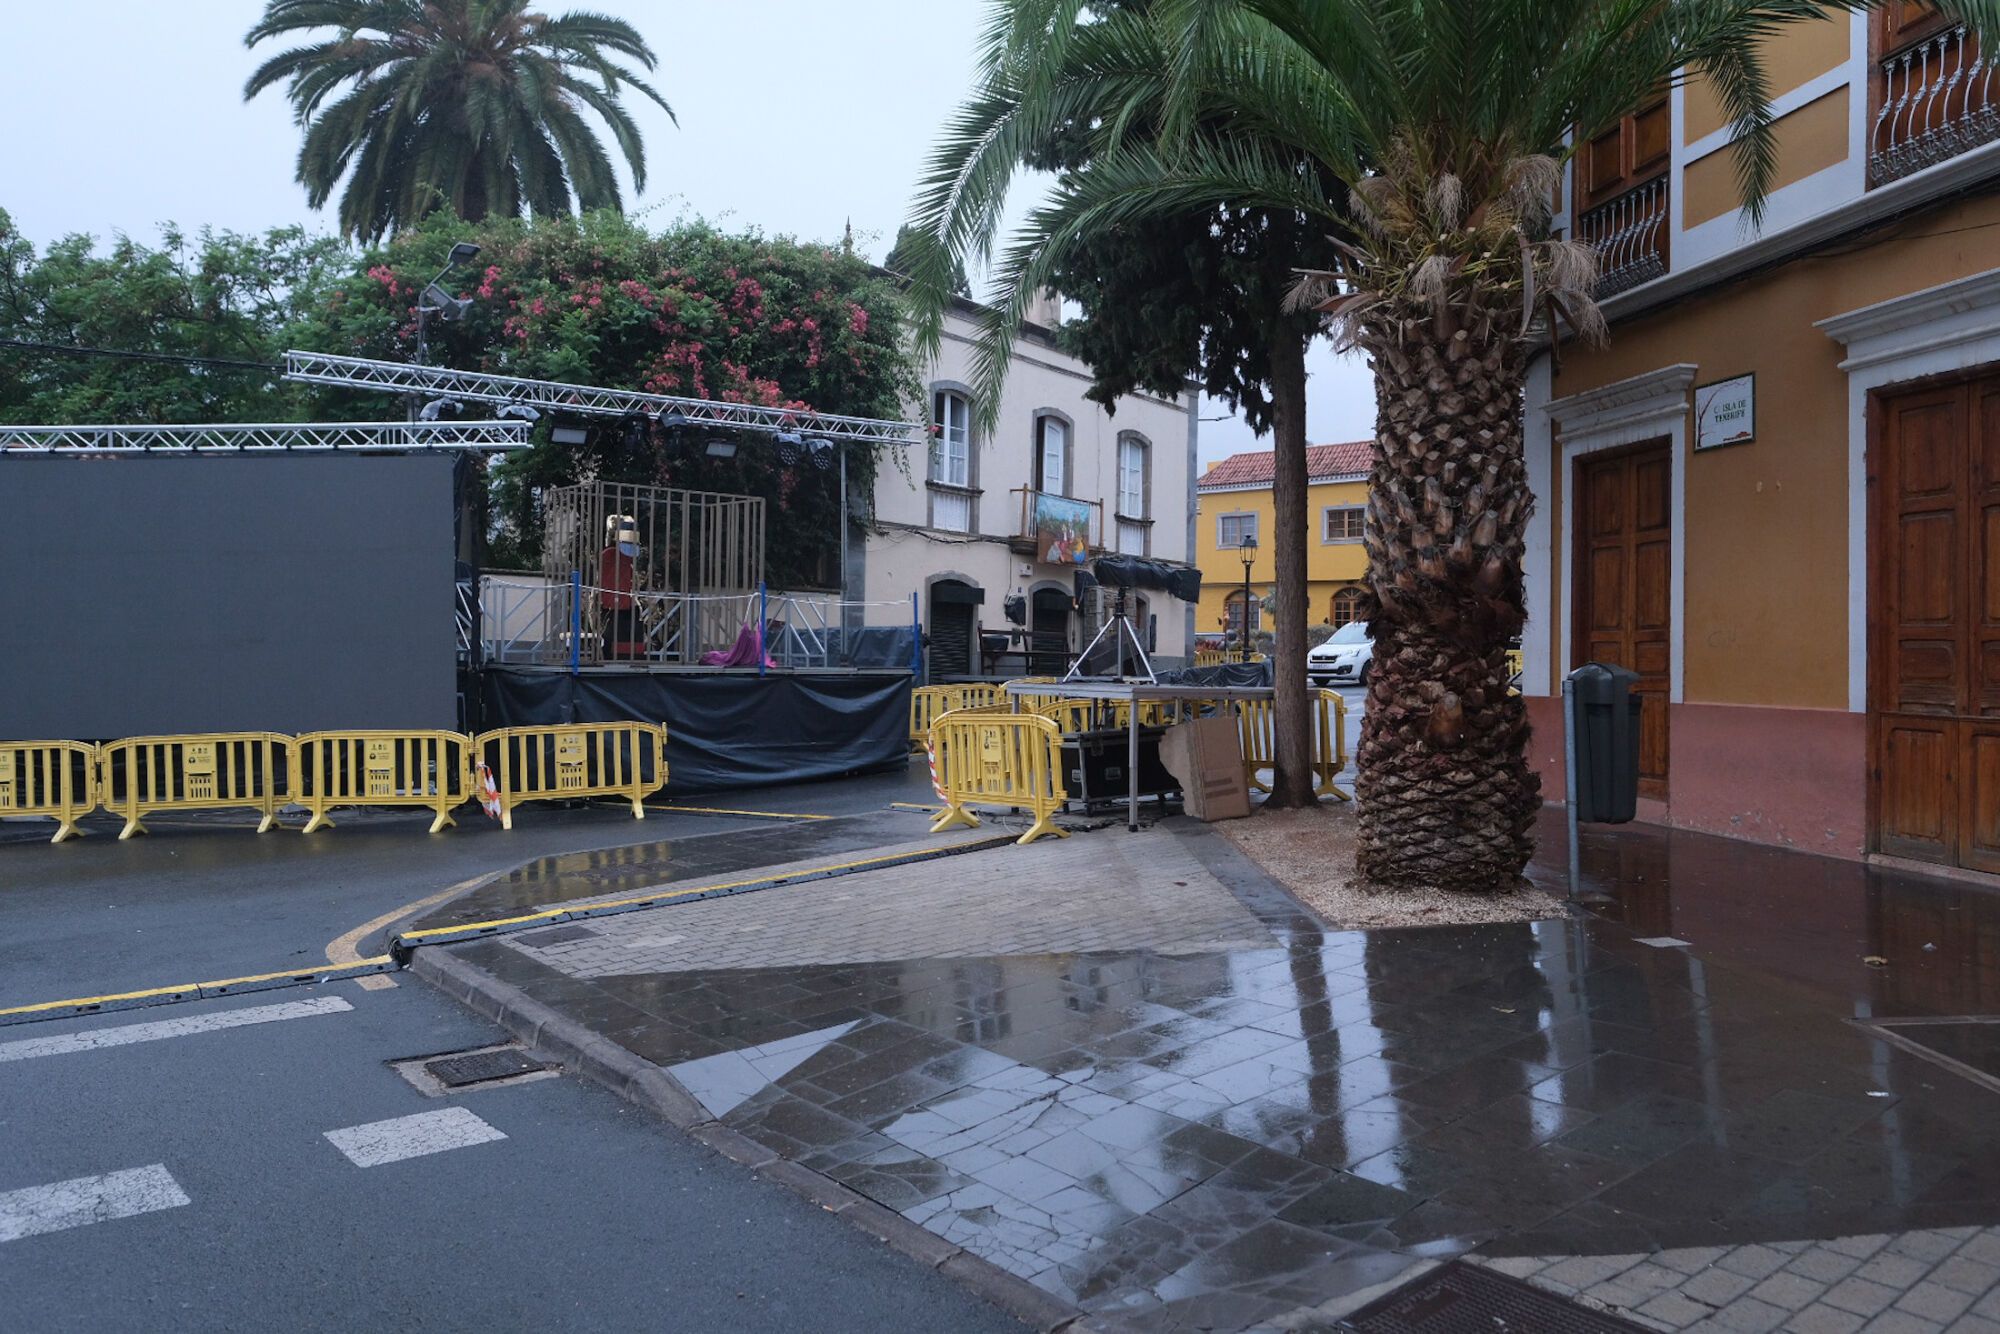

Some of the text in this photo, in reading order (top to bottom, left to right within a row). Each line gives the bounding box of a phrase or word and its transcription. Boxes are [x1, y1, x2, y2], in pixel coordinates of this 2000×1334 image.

[1723, 402, 1736, 411] ISLA
[1738, 400, 1746, 408] DE
[1715, 409, 1745, 422] TENERIFE
